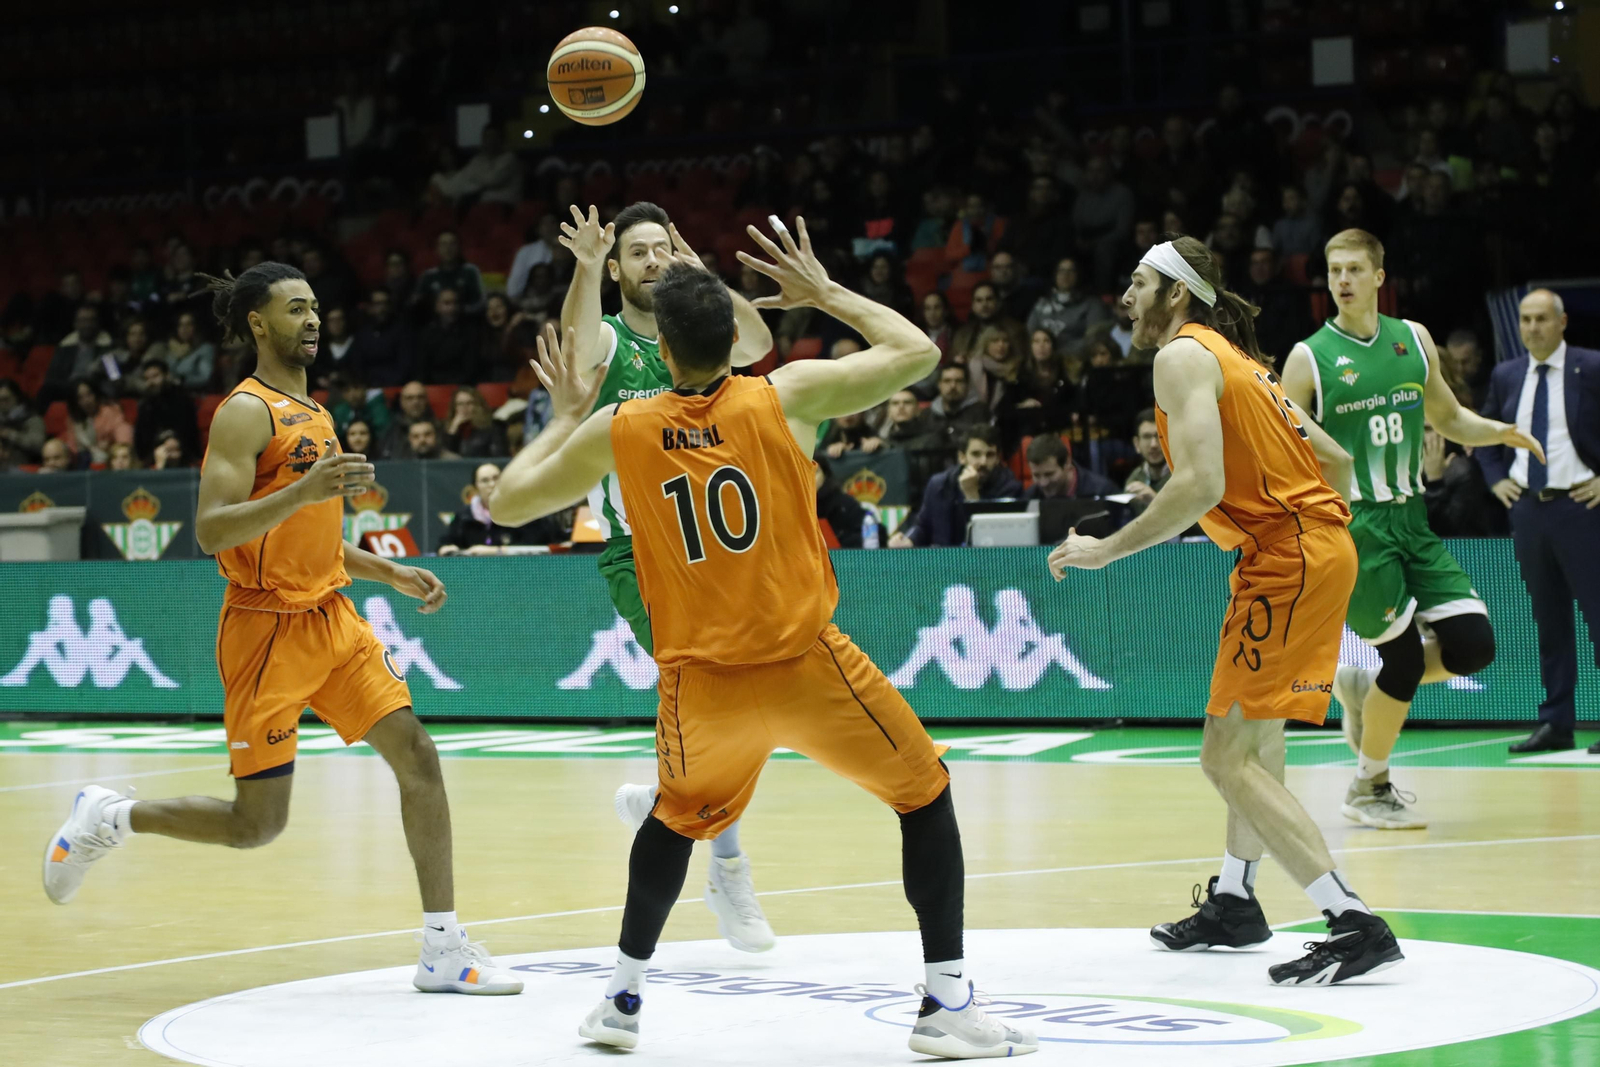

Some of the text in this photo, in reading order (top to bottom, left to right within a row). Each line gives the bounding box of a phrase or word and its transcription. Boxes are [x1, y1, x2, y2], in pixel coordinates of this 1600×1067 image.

[558, 57, 612, 75] molten
[618, 385, 673, 400] energí
[1392, 389, 1418, 406] plus
[662, 424, 724, 451] BADAL
[1368, 412, 1404, 447] 88
[660, 464, 761, 565] 10
